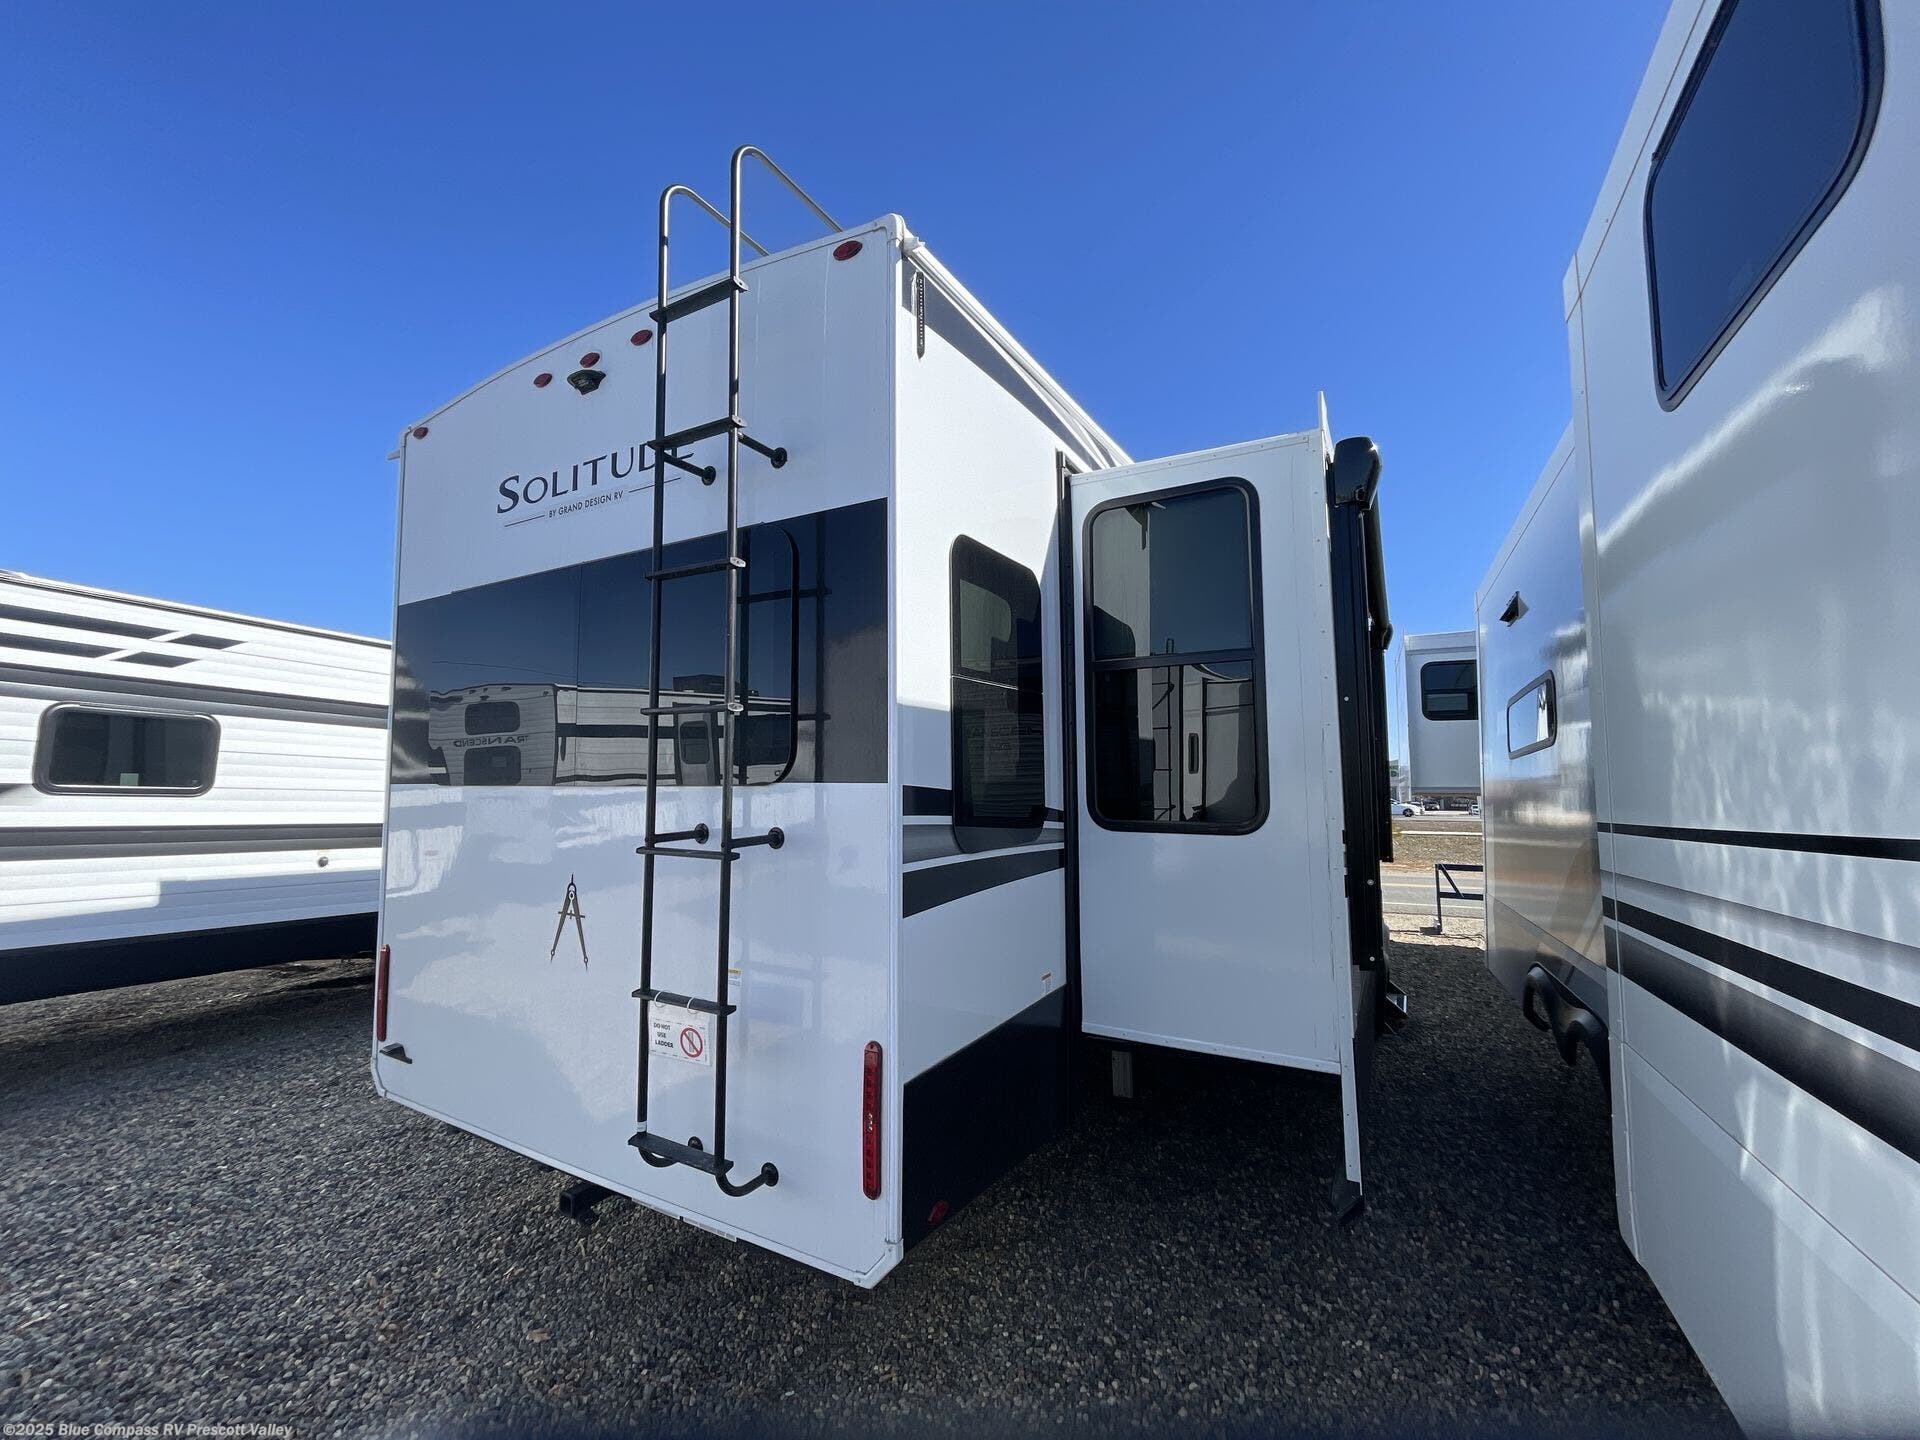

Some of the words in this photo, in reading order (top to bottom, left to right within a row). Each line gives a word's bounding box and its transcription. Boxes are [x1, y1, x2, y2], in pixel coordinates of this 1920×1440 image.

[548, 509, 557, 518] BY
[558, 501, 583, 515] GRAND
[585, 493, 612, 508] DESIGN
[613, 490, 624, 500] RV
[655, 1040, 673, 1048] LADDER
